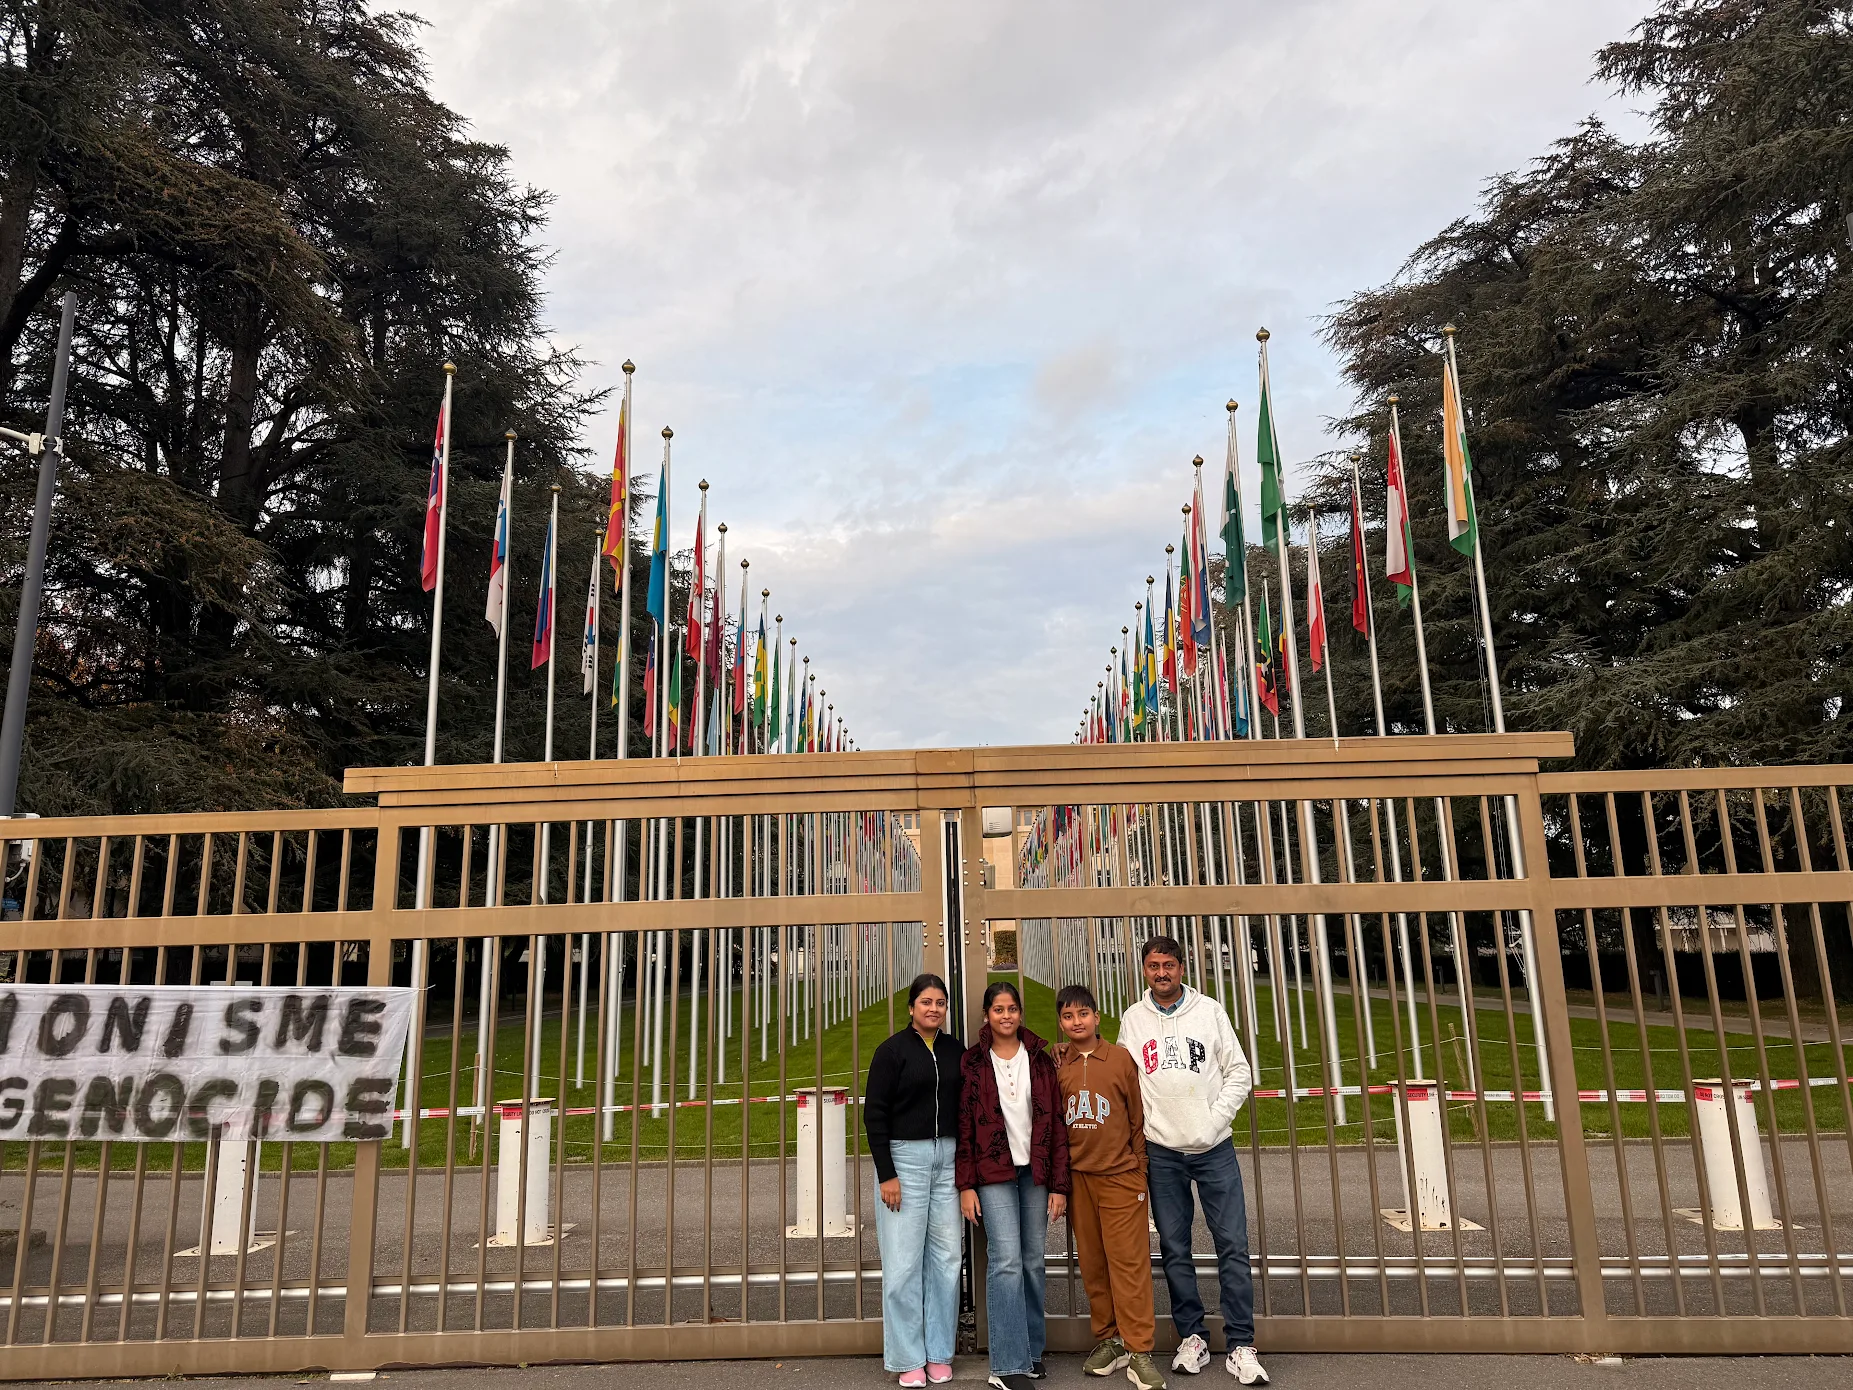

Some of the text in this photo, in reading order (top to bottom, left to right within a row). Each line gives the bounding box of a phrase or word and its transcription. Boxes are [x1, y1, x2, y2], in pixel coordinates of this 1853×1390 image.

[1142, 1036, 1206, 1074] GAP
[0, 1073, 392, 1139] GENOCIDE
[1065, 1090, 1110, 1125] GAP
